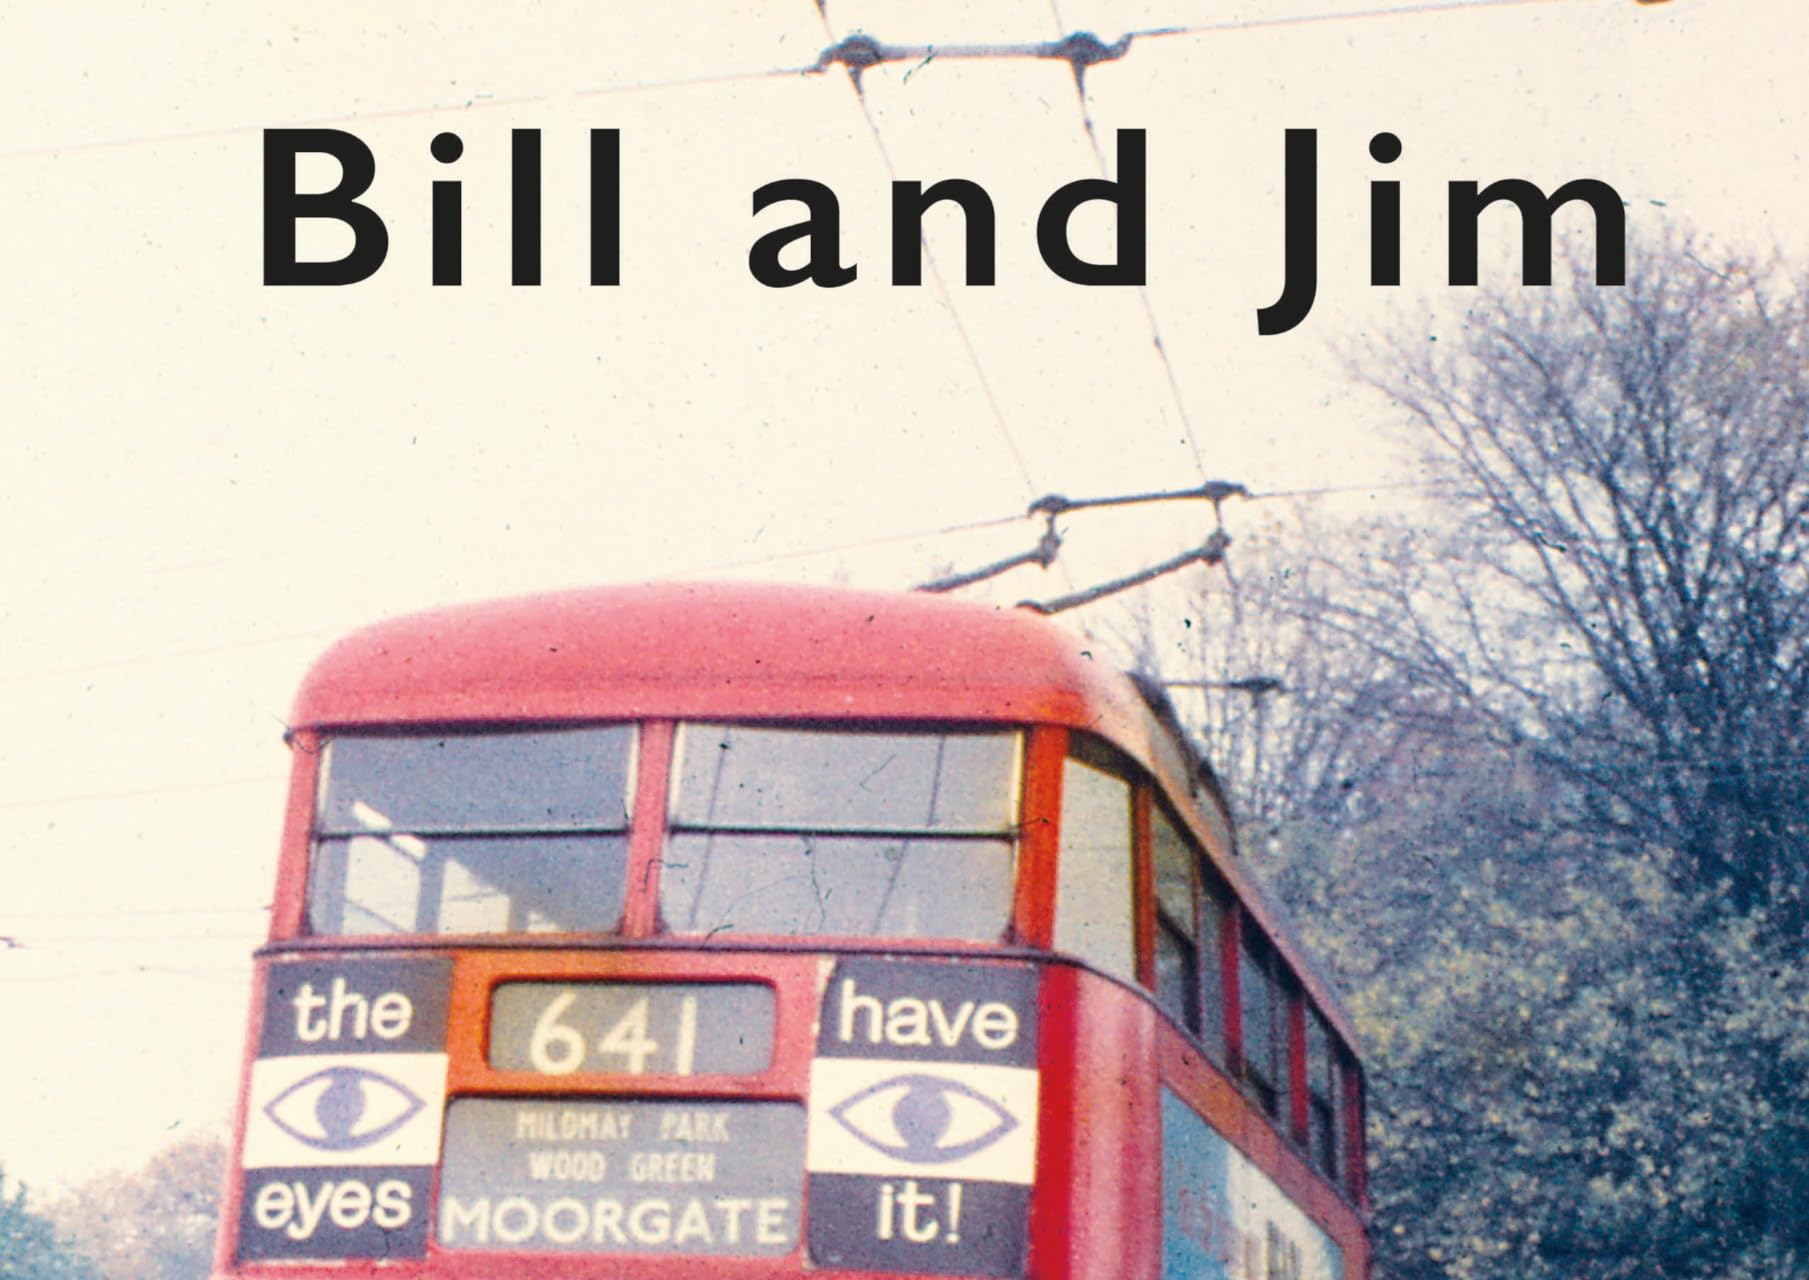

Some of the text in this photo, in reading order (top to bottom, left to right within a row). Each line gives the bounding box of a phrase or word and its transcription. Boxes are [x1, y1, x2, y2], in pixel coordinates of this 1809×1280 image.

[292, 977, 413, 1042] the
[530, 991, 698, 1077] 641
[838, 978, 1019, 1050] have
[516, 1110, 732, 1143] MILDMAY PARK
[529, 1151, 717, 1184] WOOD GREEN
[253, 1179, 412, 1240] eyes
[440, 1196, 790, 1246] MOORGATE
[877, 1180, 962, 1244] it!
